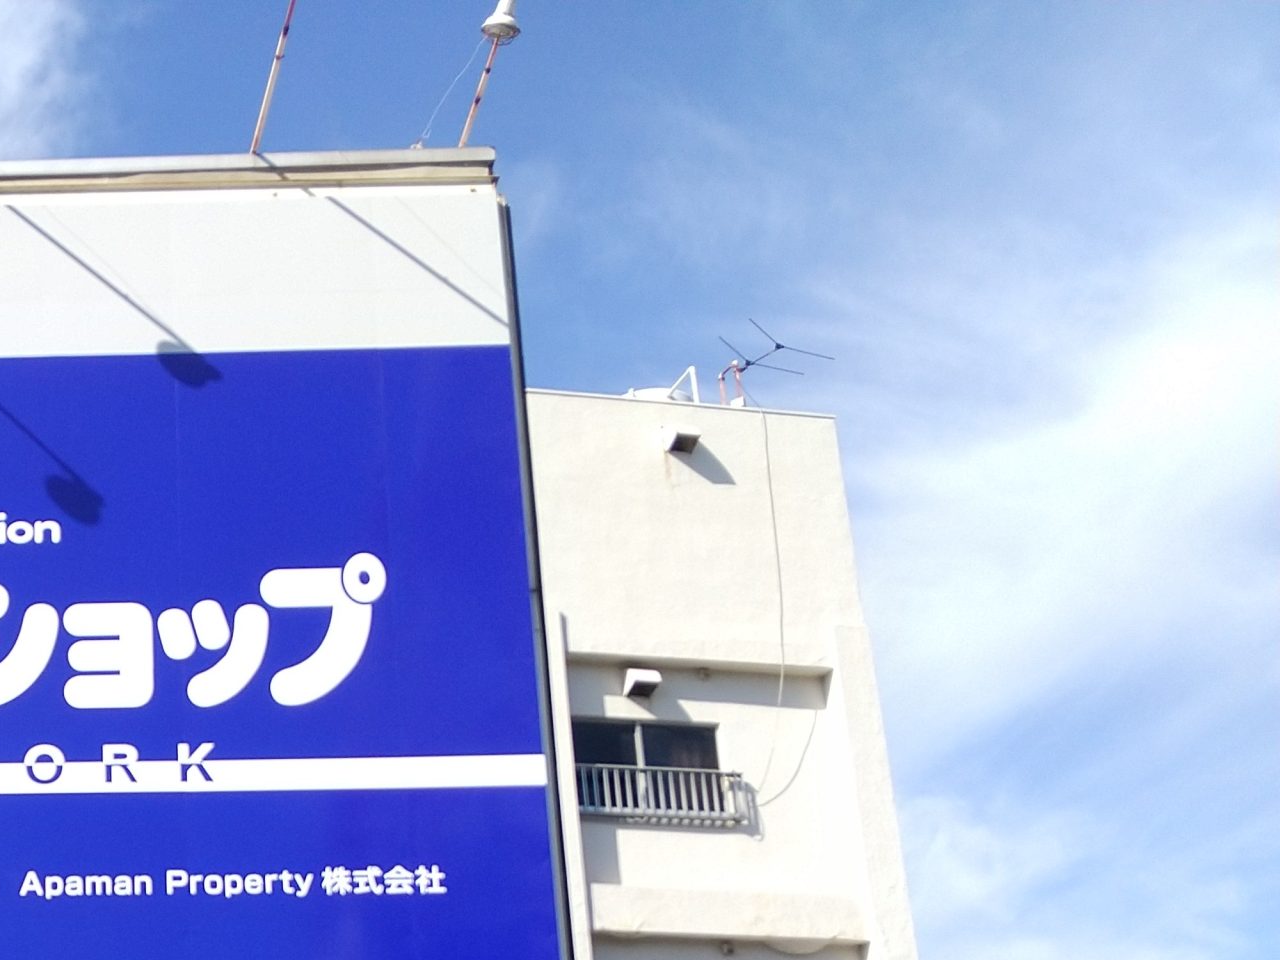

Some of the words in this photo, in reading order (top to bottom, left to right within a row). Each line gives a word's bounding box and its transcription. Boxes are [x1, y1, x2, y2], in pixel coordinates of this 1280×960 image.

[19, 870, 153, 900] Apaman
[165, 869, 314, 899] Property
[321, 864, 448, 896] 株式会社
